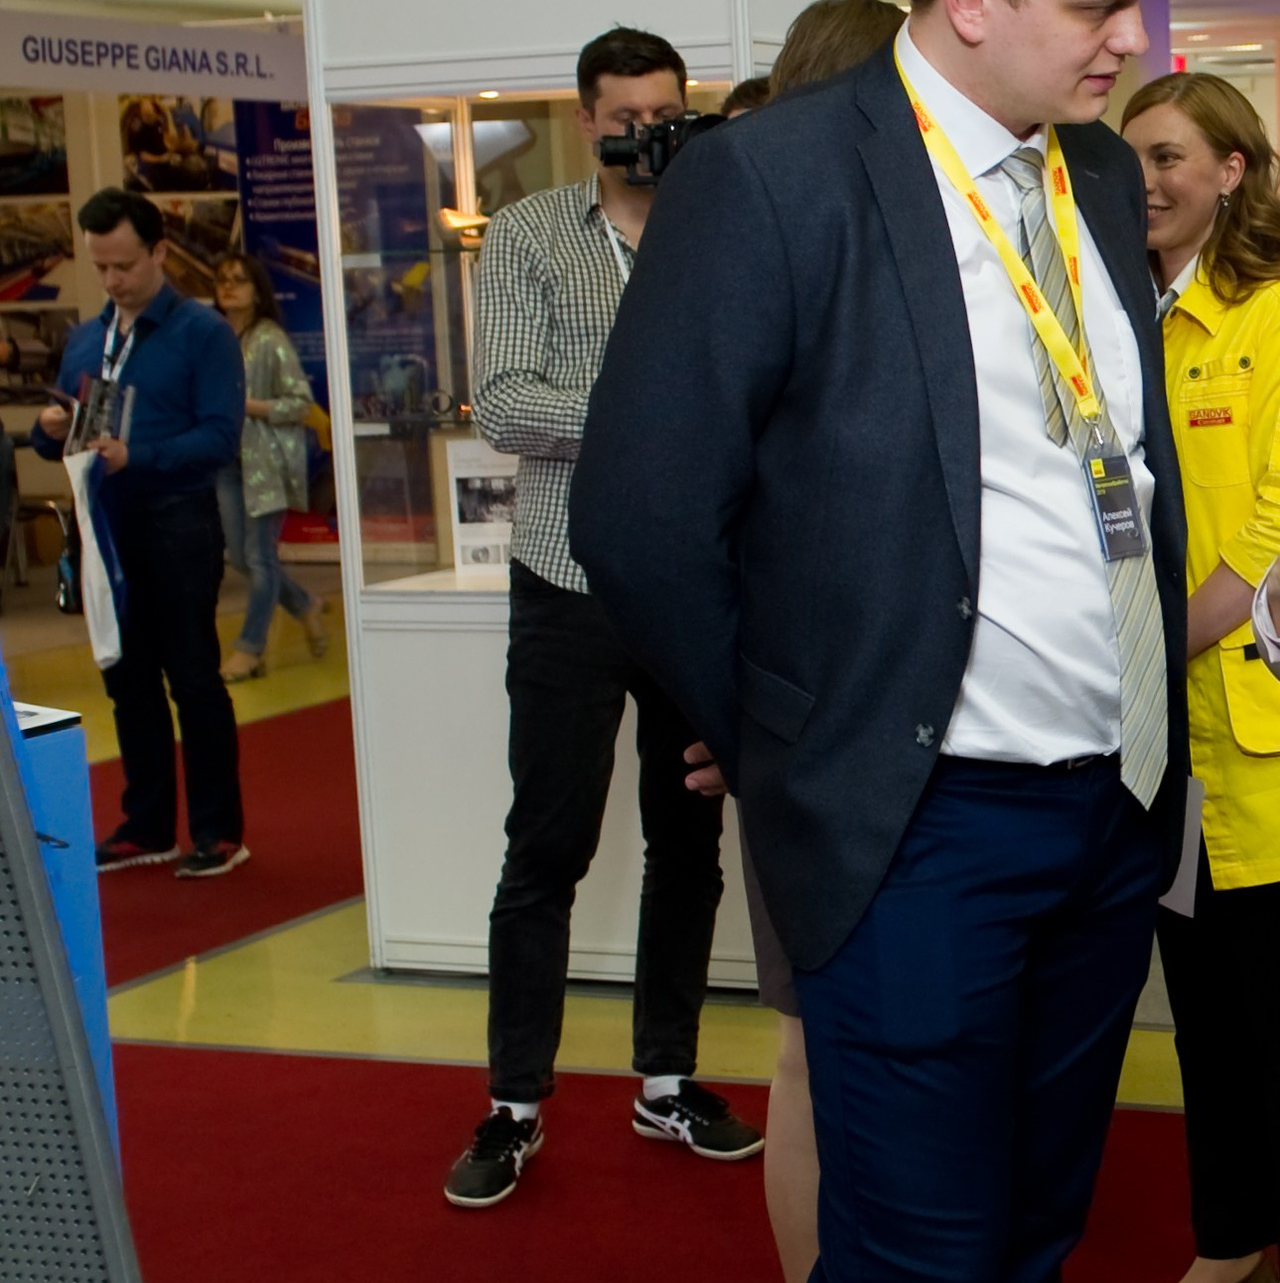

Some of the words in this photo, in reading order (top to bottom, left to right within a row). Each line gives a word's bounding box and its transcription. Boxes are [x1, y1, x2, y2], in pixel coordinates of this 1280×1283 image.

[22, 34, 140, 70] GIUSEPPE
[144, 44, 213, 74] GIANA
[215, 50, 275, 80] S.R.L.
[1188, 407, 1232, 420] SANDVIK
